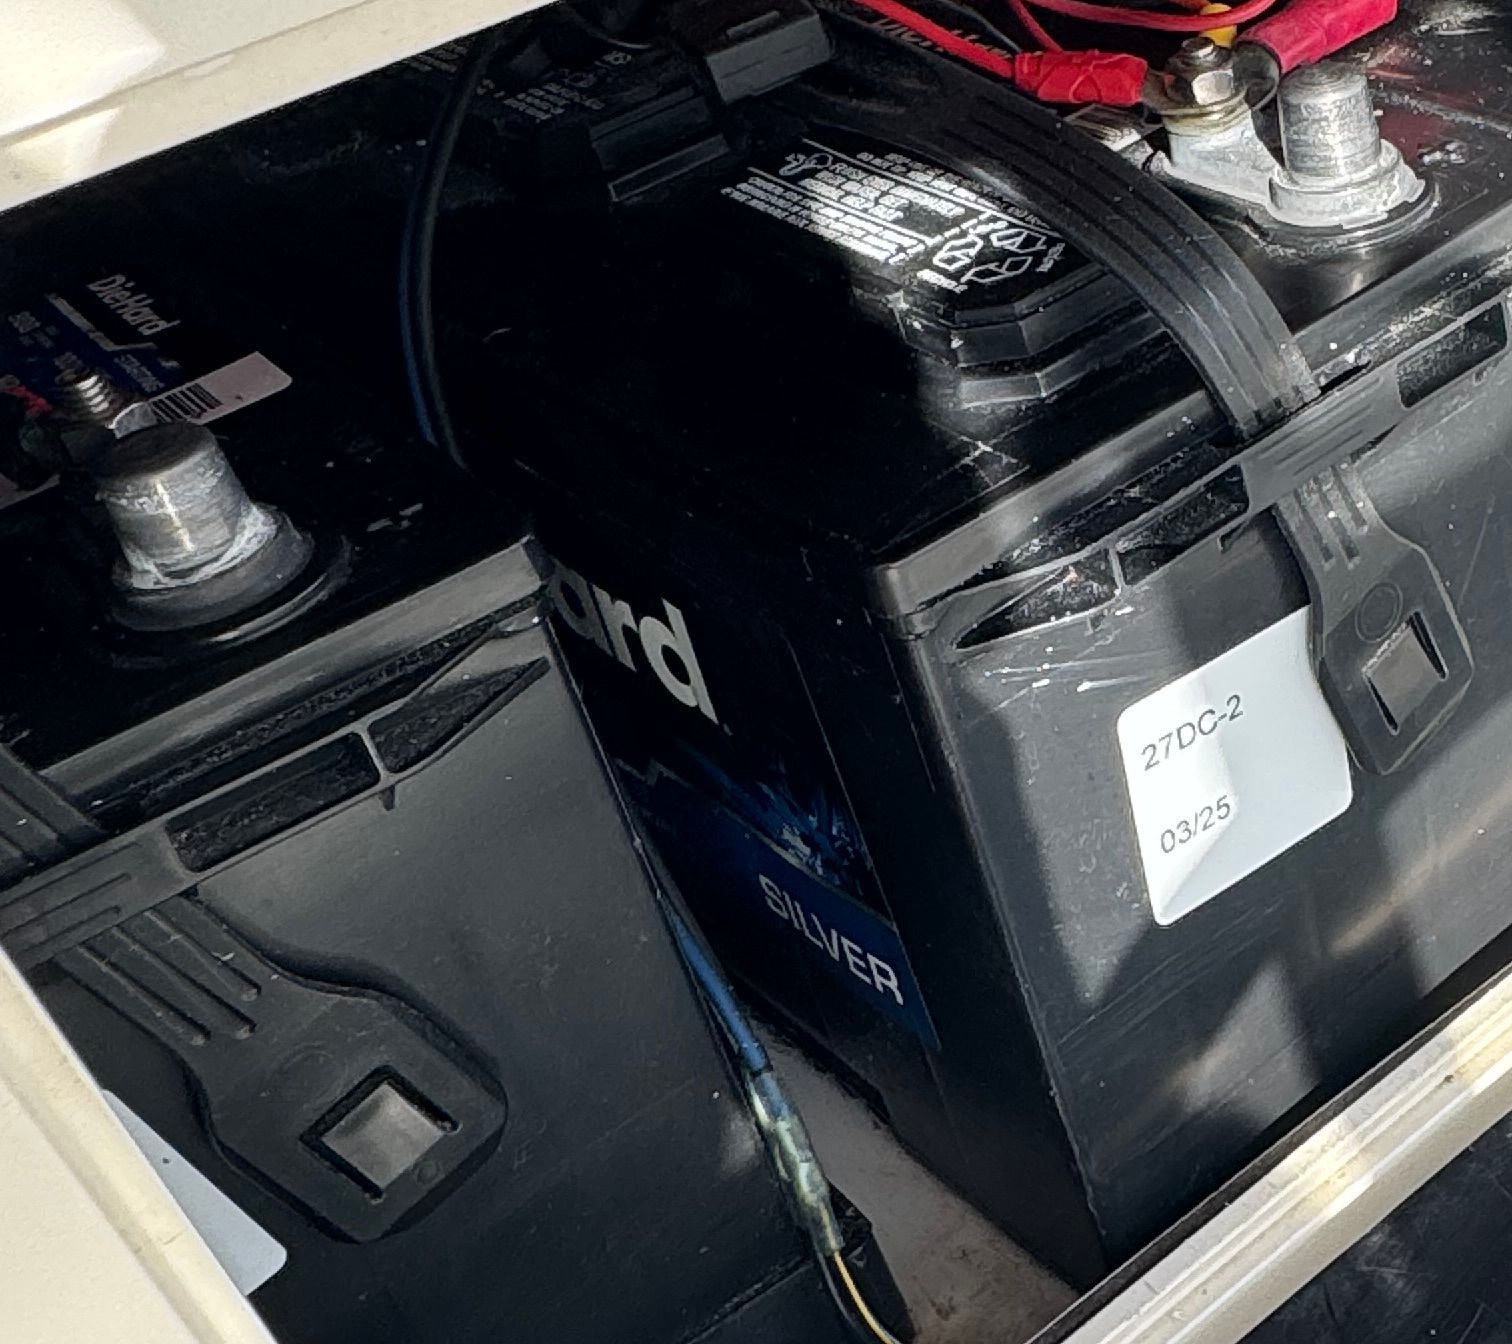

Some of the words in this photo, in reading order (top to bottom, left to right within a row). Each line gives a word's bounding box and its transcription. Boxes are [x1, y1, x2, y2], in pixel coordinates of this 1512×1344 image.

[86, 274, 181, 336] DieHard
[1141, 694, 1244, 771] 27DC-2
[1160, 794, 1231, 854] 03/25
[758, 873, 904, 1006] SILVER
